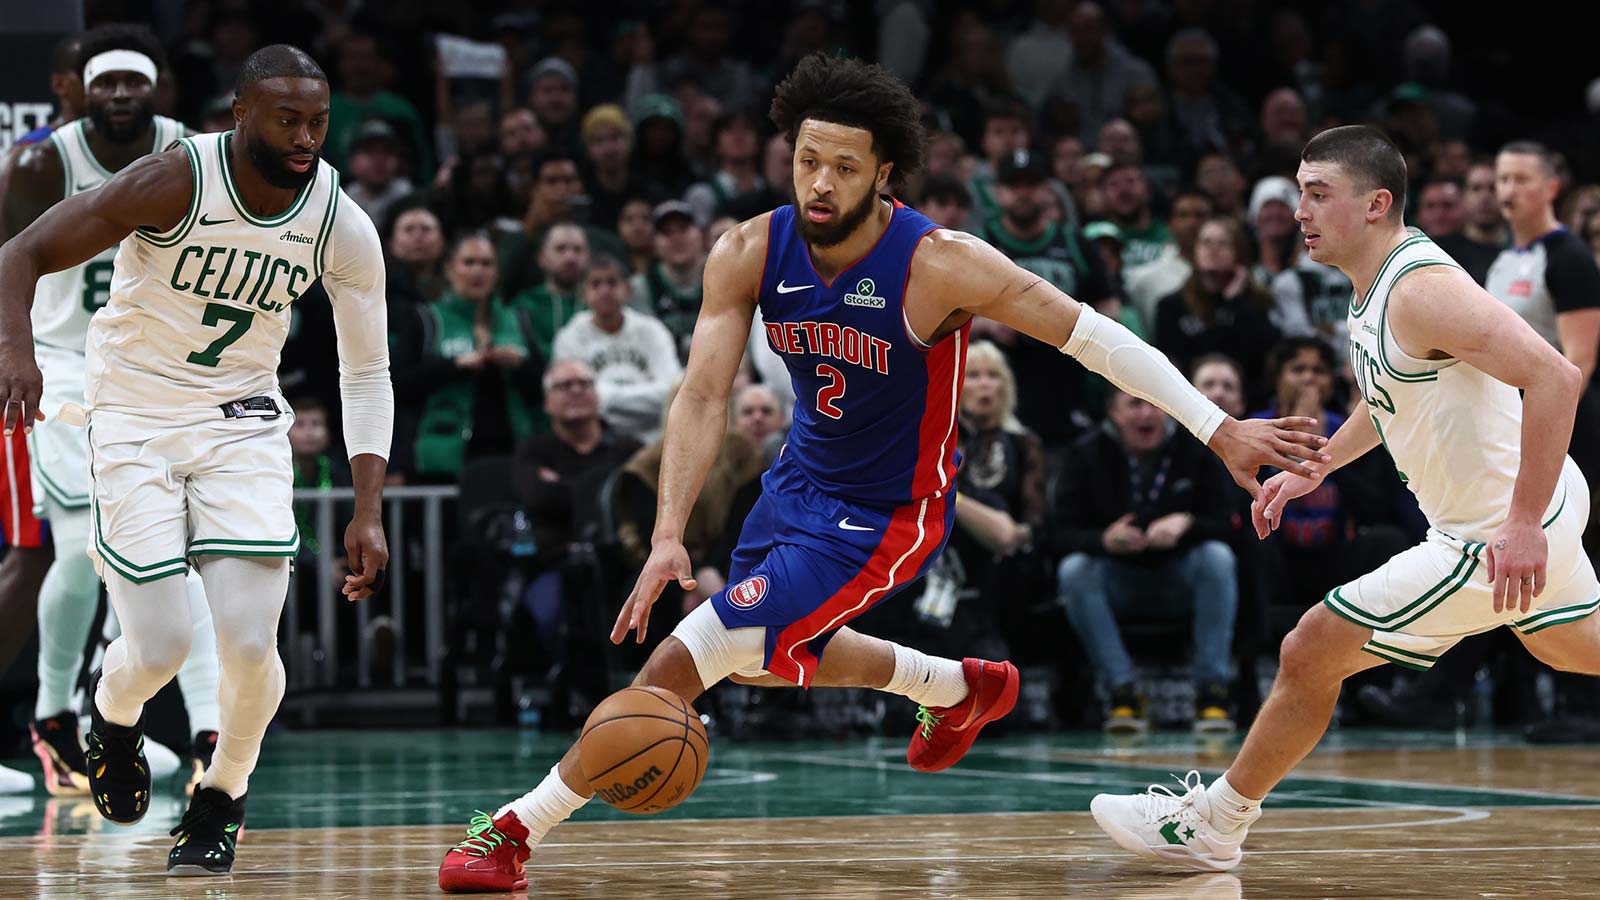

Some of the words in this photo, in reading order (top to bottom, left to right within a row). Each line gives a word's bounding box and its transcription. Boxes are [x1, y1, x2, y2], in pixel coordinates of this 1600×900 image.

[280, 231, 314, 245] Amica
[170, 246, 308, 313] CELTICS
[845, 294, 884, 307] StockX
[186, 302, 256, 368] 7
[764, 321, 892, 375] DETROIT
[816, 363, 846, 420] 2
[594, 765, 663, 804] Wilson
